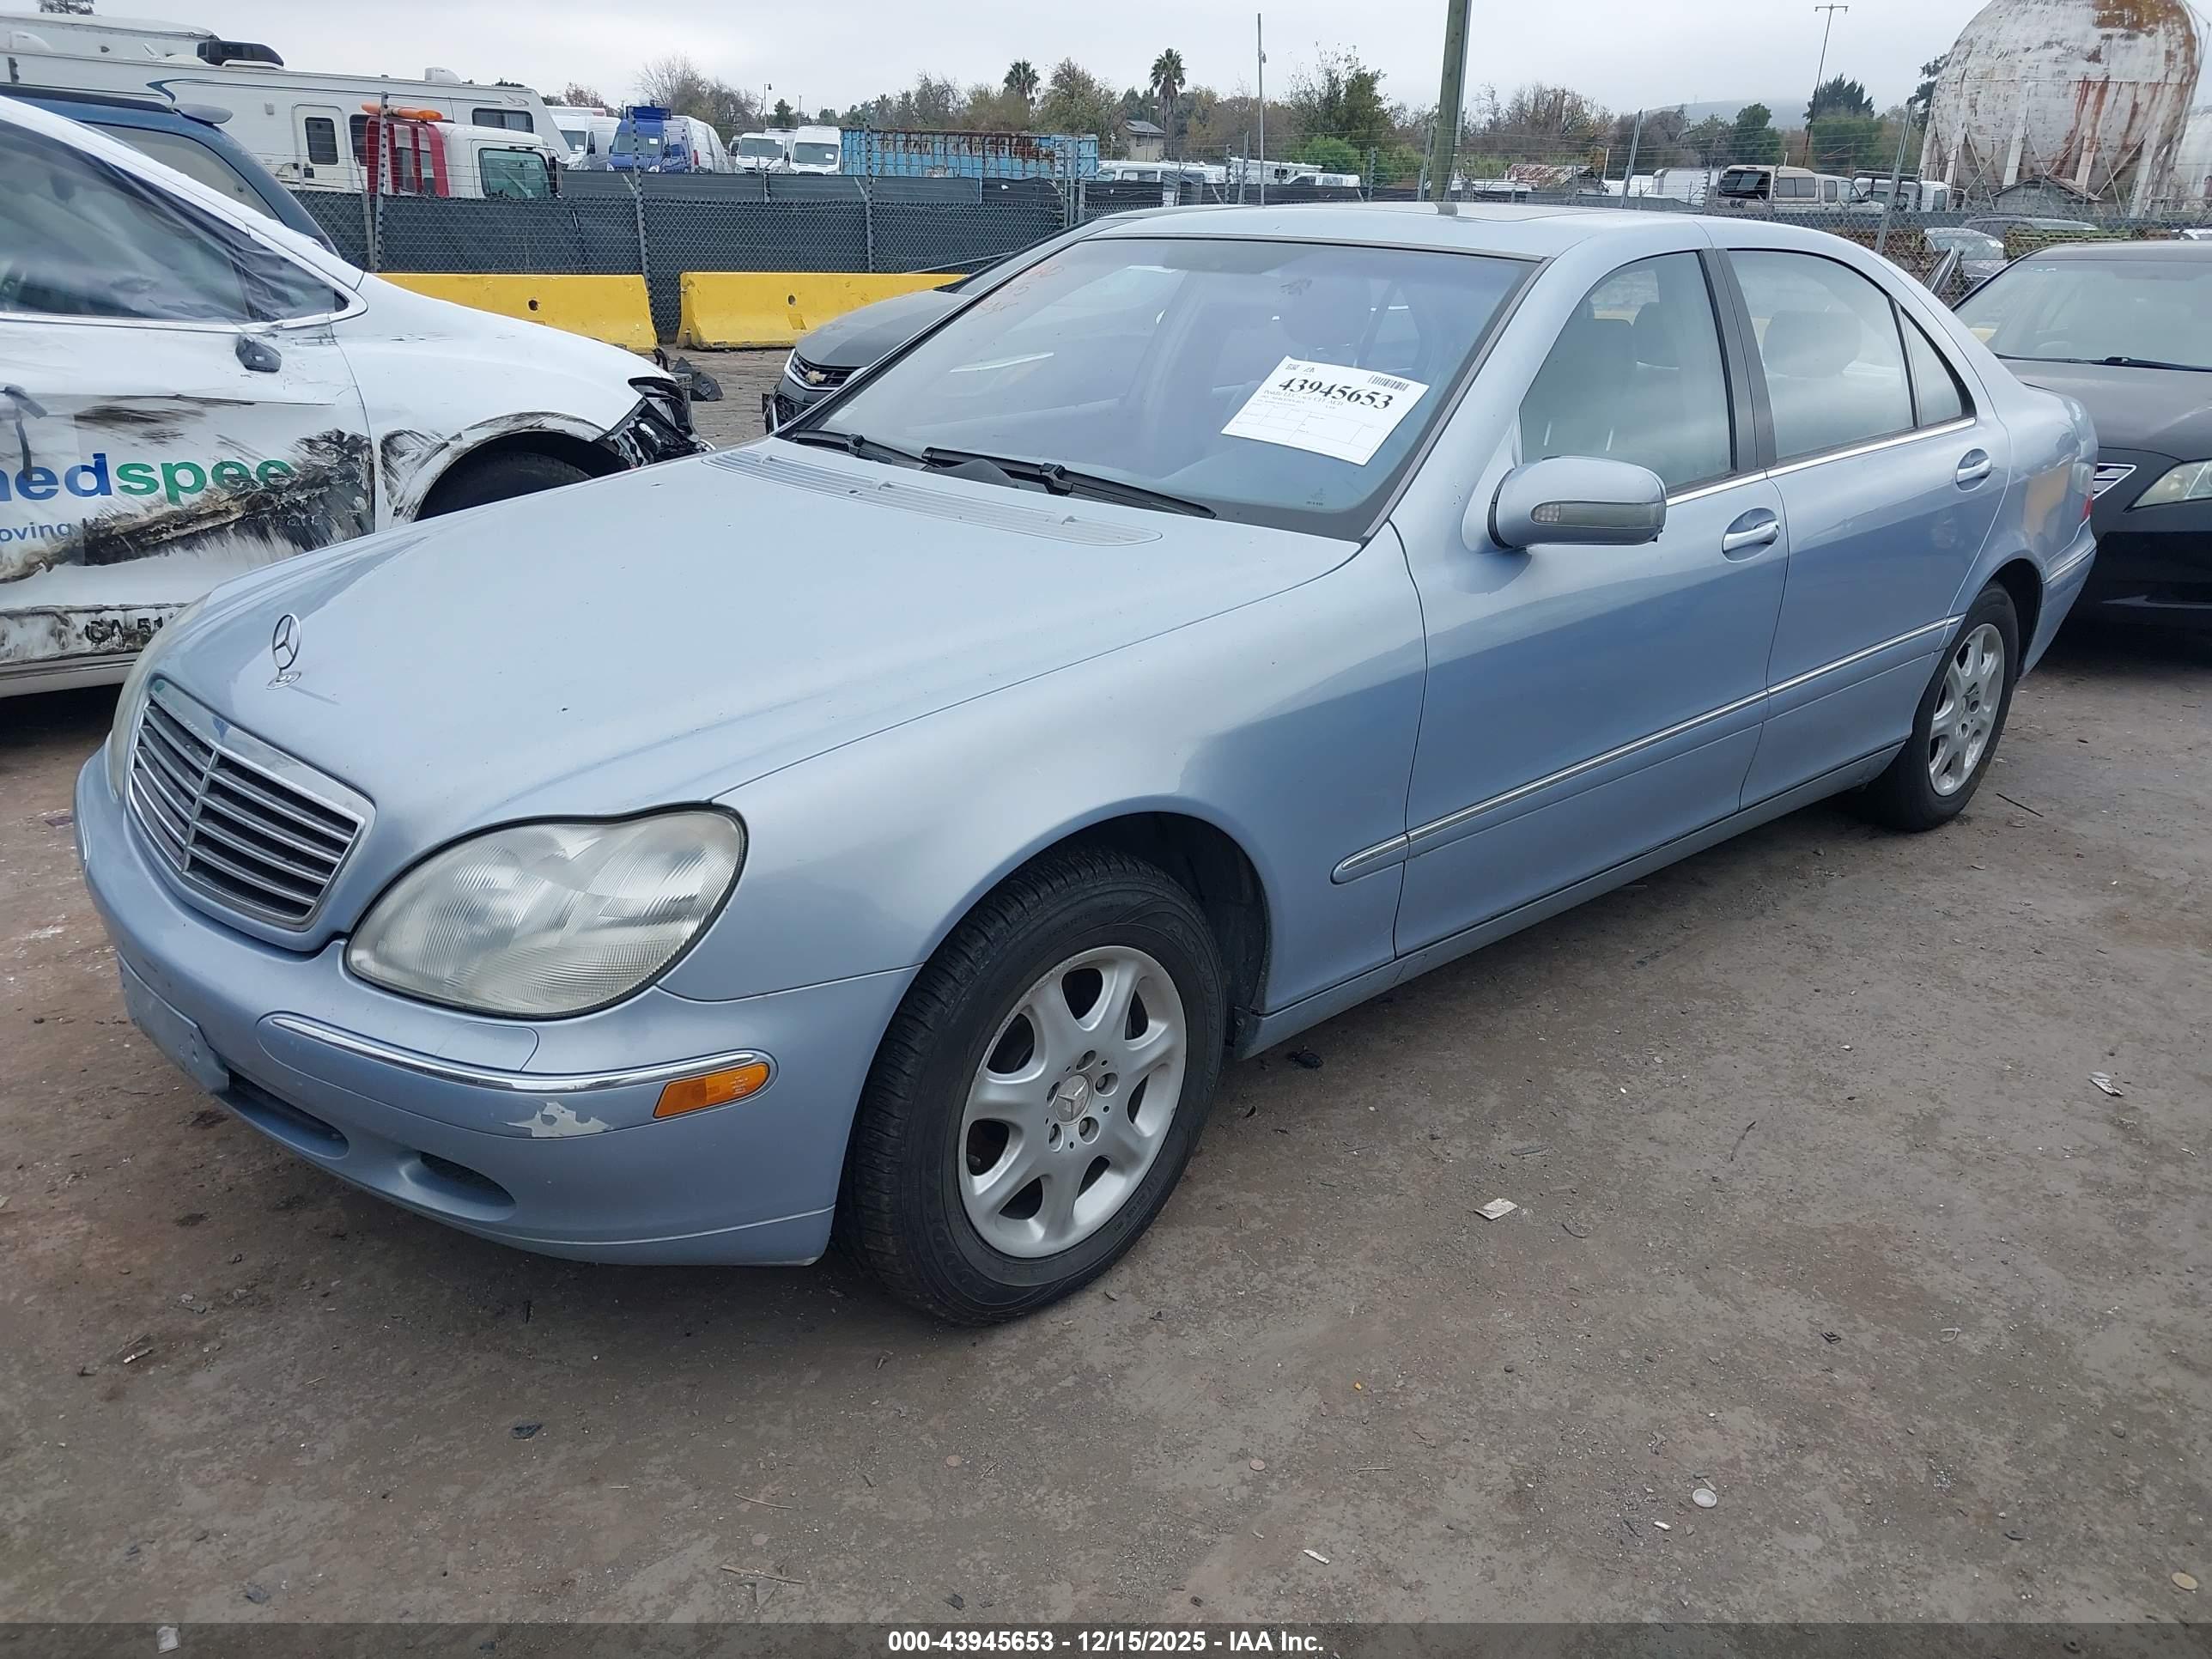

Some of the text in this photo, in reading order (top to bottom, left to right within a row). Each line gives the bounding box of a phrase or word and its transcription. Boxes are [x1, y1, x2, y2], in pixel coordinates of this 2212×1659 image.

[1279, 377, 1394, 410] 43945653
[0, 453, 297, 506] edspee
[0, 521, 71, 543] oving
